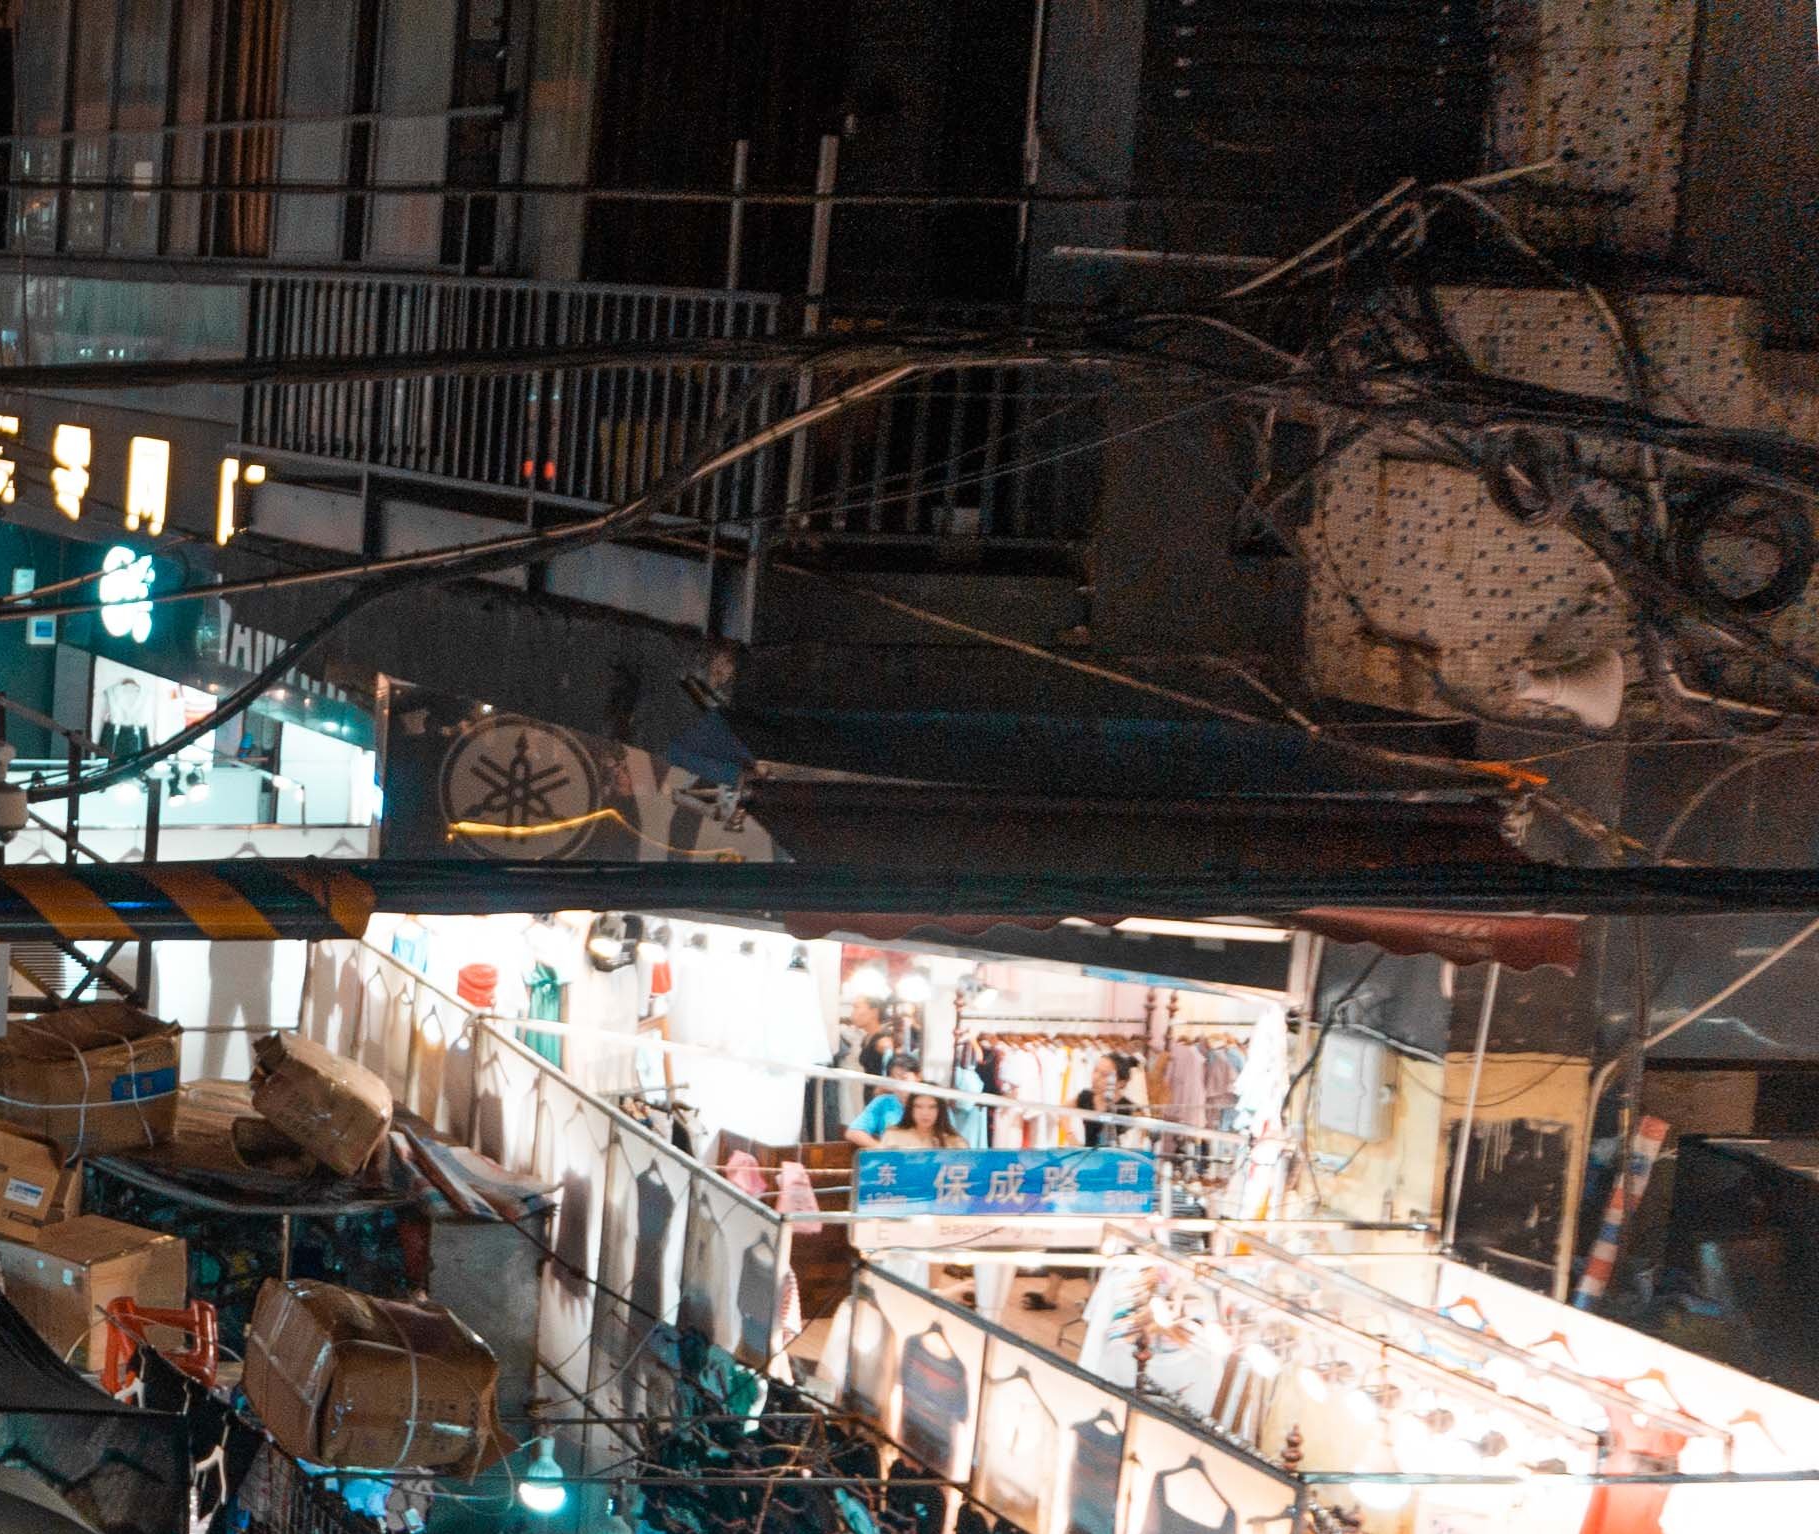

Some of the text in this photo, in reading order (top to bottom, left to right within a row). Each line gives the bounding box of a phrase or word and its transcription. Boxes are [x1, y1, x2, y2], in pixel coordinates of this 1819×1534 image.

[933, 1160, 1081, 1205] 保成路
[1117, 1160, 1140, 1185] 西
